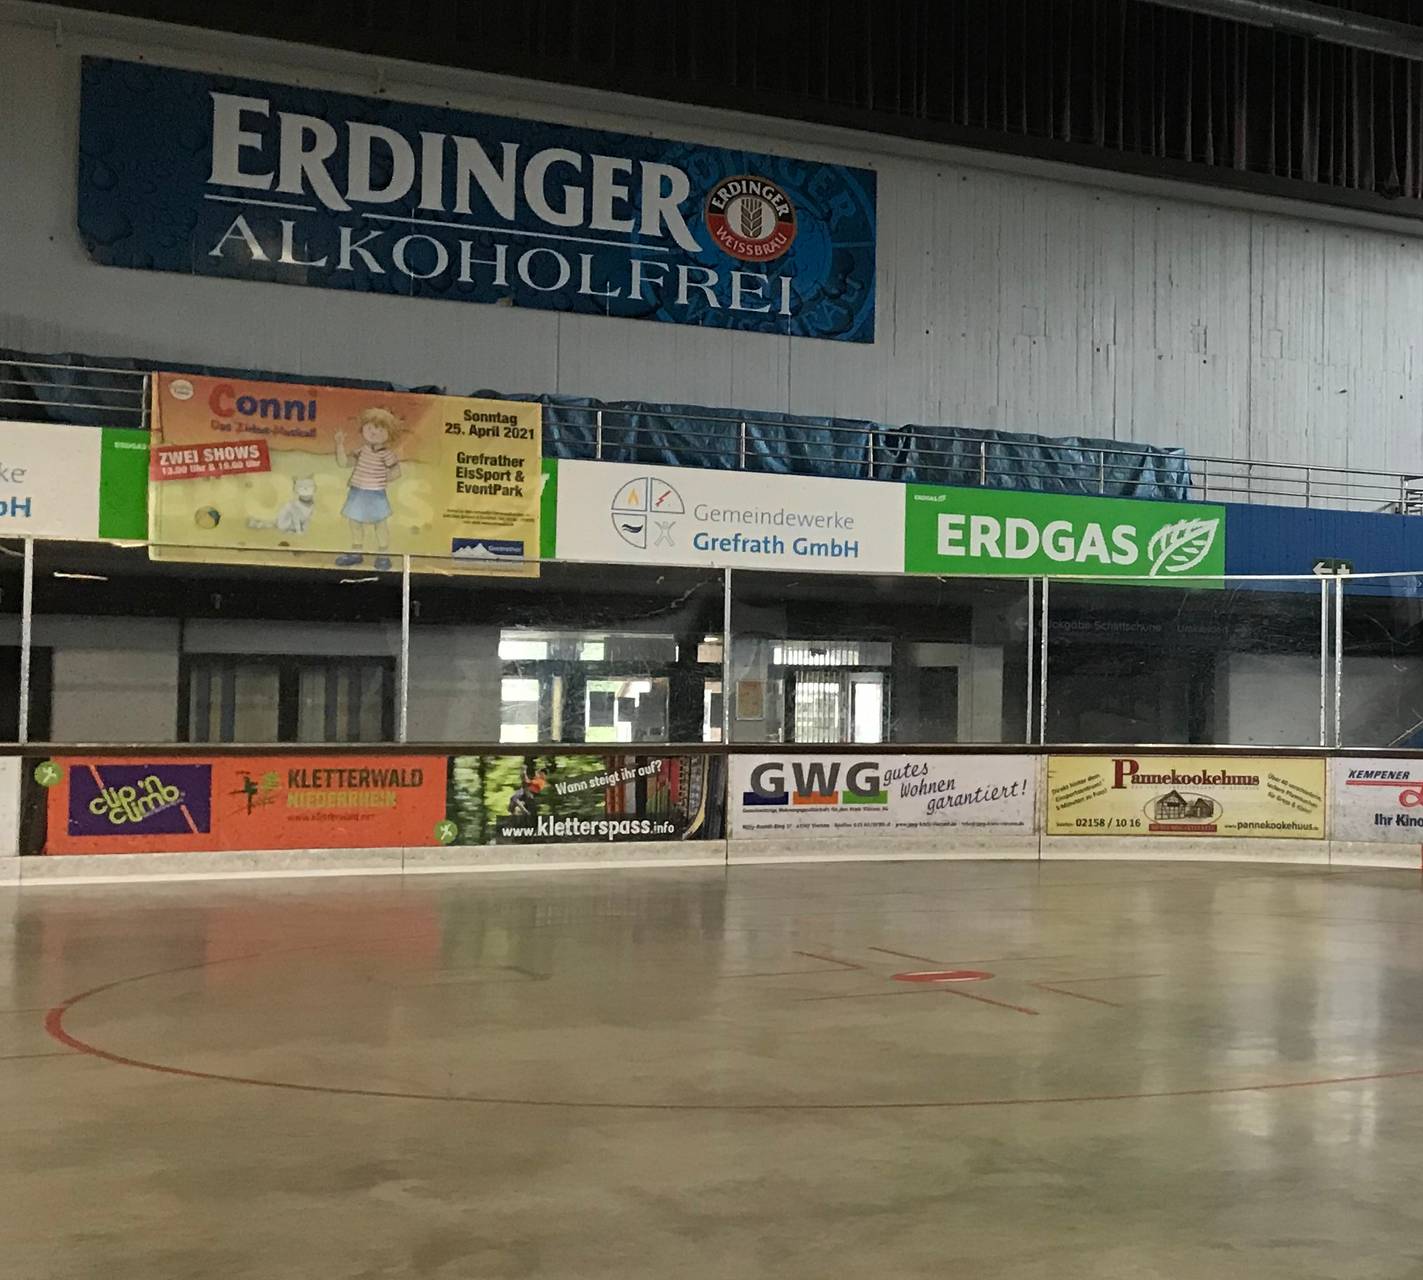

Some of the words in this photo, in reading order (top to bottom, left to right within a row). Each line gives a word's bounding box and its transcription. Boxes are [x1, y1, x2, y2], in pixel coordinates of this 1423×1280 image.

[207, 91, 703, 253] ERDINGER
[711, 180, 790, 217] ERDINGER
[208, 213, 793, 316] ALKOHOLFREI
[208, 383, 318, 421] Conni
[464, 409, 517, 426] Sonntag
[445, 423, 465, 435] 25.
[469, 425, 500, 439] April
[504, 427, 534, 439] 2021
[159, 450, 199, 466] ZWEI
[203, 445, 260, 463] SHOWS
[457, 452, 525, 468] Grefrather
[456, 467, 511, 482] EisSport
[515, 471, 525, 483] &
[456, 481, 523, 497] EventPark
[694, 504, 854, 530] Gemeindewerke
[693, 532, 784, 554] Grefrath
[792, 538, 859, 558] GmbH
[937, 513, 1138, 566] ERDGAS
[288, 767, 424, 789] KLETTERWALD
[555, 780, 588, 796] Wann
[590, 771, 620, 790] steigt
[622, 766, 637, 782] ihr
[638, 759, 663, 778] auf?
[750, 761, 881, 798] GWG
[884, 762, 928, 787] gutes
[1111, 759, 1260, 790] Pannekookehuus
[1348, 770, 1410, 780] KEMPENER
[287, 791, 397, 809] NIEDERRHEIN
[900, 777, 956, 799] Wohnen
[927, 779, 1027, 816] garantiert!
[502, 815, 675, 841] www.kletterspass.info
[1075, 818, 1105, 828] 02158
[1107, 817, 1113, 829] /
[1116, 818, 1127, 828] 10
[1130, 818, 1141, 828] 16
[1374, 813, 1392, 827] Ihr
